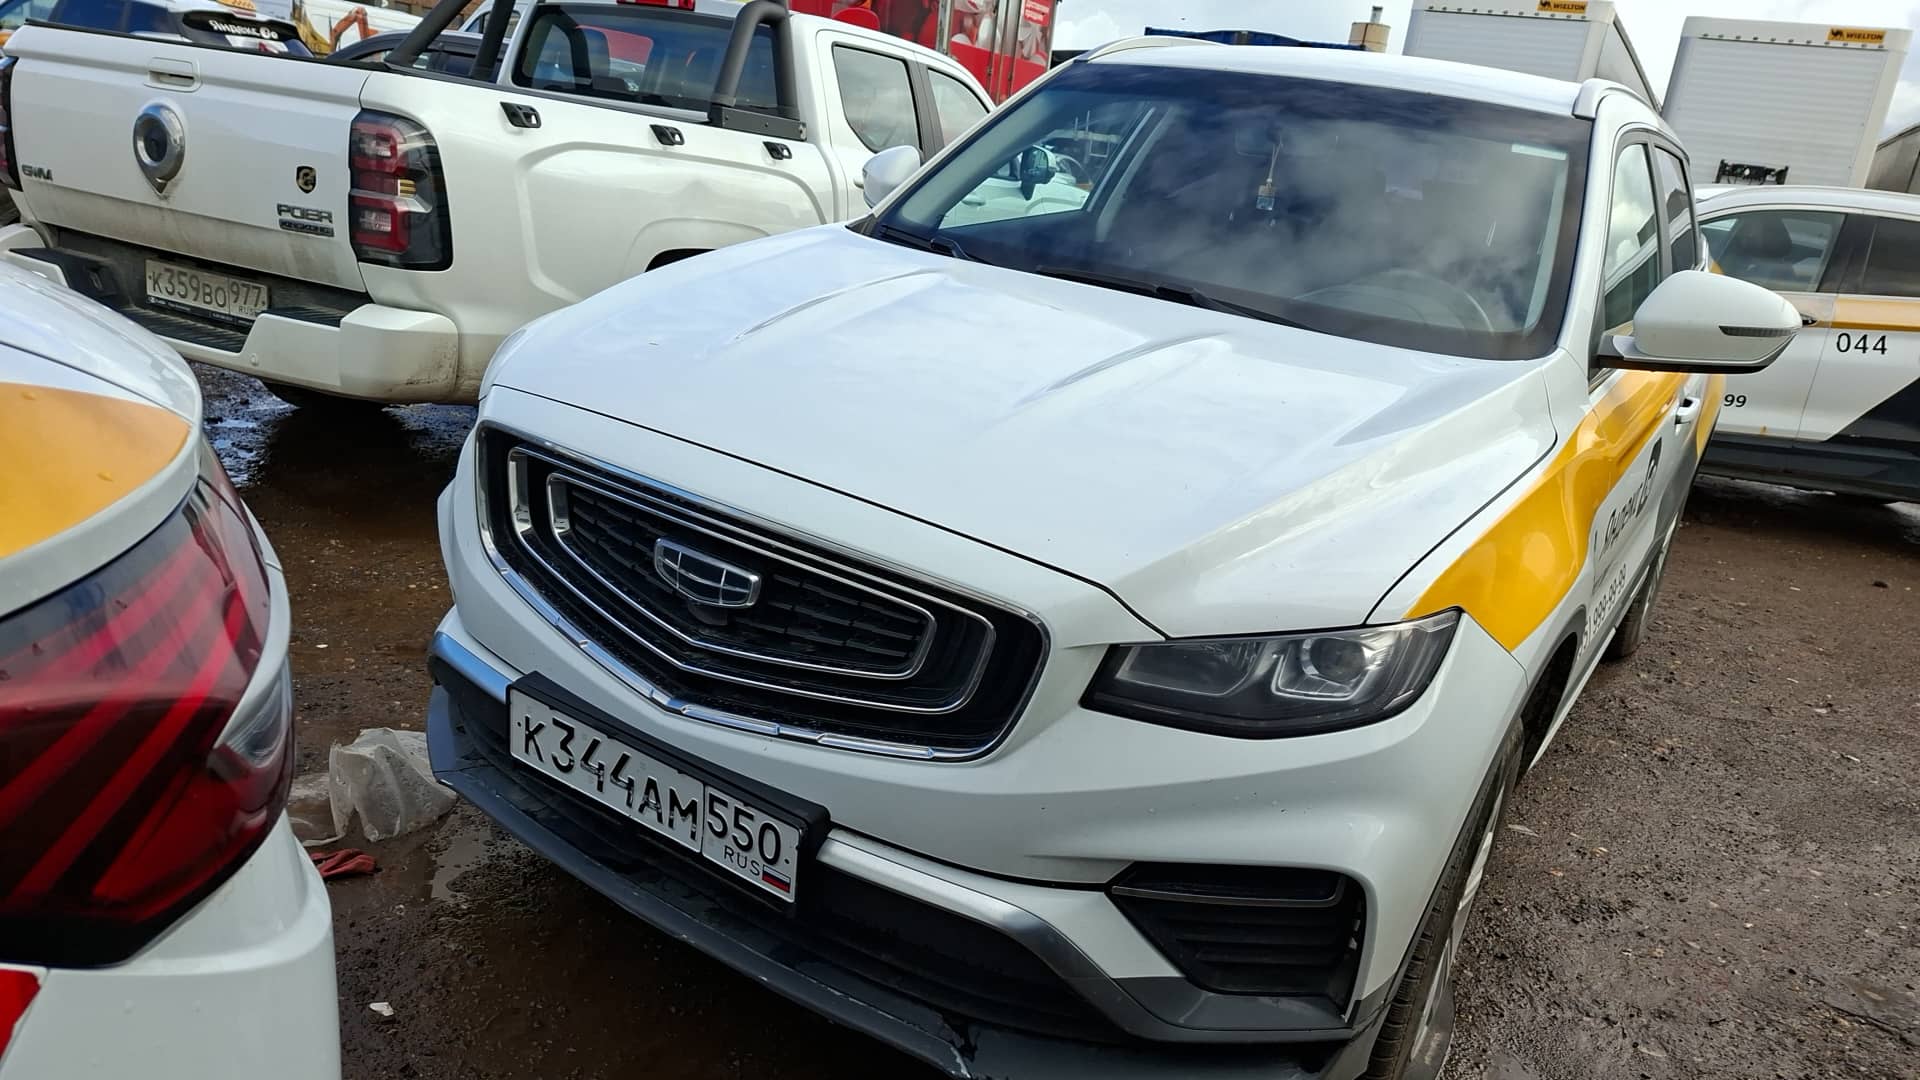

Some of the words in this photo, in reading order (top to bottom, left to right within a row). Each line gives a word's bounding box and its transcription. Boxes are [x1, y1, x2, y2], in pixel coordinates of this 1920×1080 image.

[230, 281, 262, 308] 977
[1836, 332, 1888, 355] 044
[1723, 393, 1747, 408] 99
[523, 714, 699, 842] К344АМ
[706, 790, 782, 867] 550
[723, 844, 760, 877] RUS
